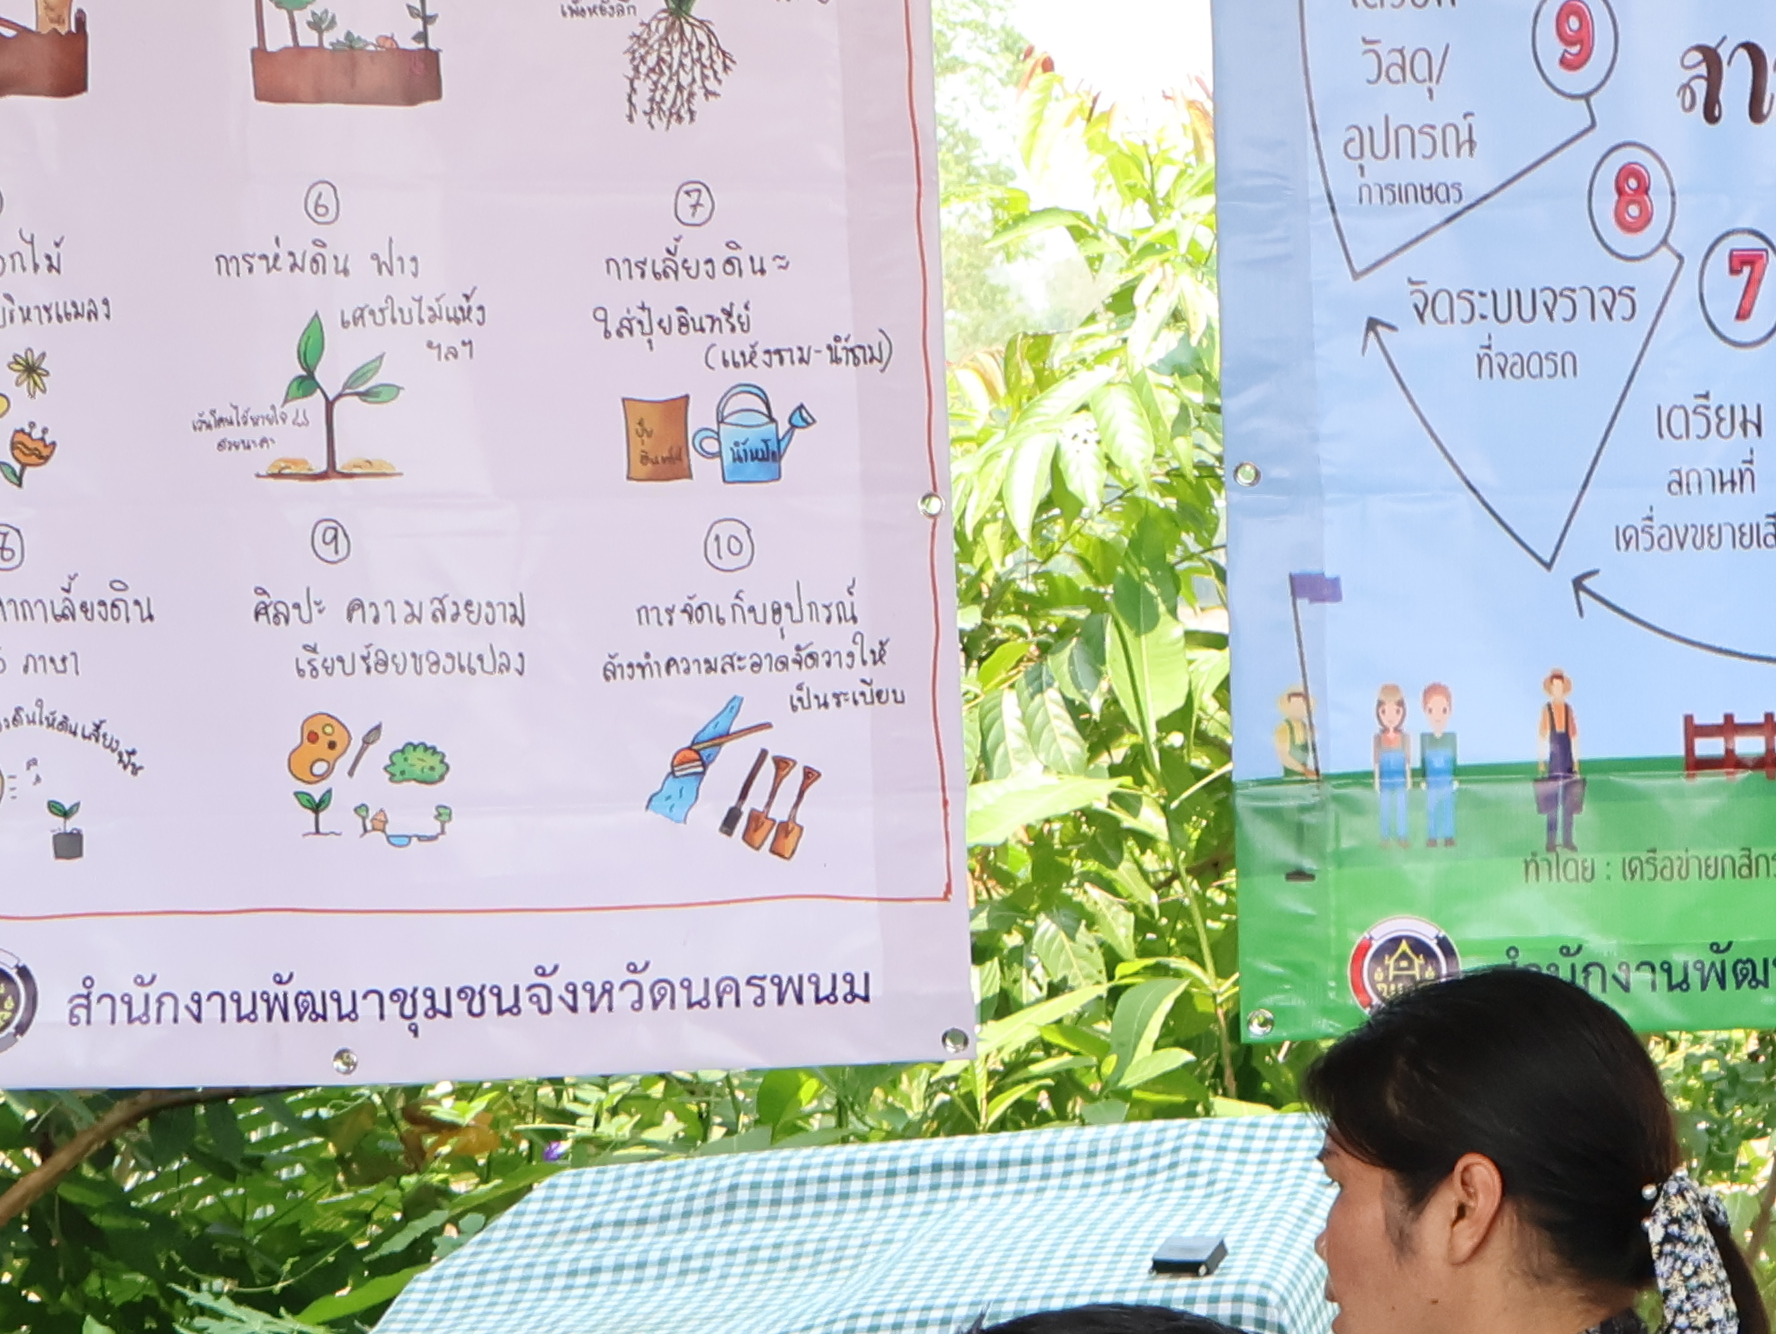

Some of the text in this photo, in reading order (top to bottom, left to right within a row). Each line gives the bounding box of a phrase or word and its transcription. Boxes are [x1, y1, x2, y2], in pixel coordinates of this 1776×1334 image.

[1361, 36, 1451, 101] วัสดุ/
[1343, 112, 1478, 179] อุปกรณ์
[1357, 180, 1464, 207] การเกษตร
[1612, 161, 1655, 236] 8
[215, 236, 421, 278] การห่มดิน ฟาง
[605, 235, 767, 281] การเลี้ยงดิน
[340, 286, 486, 330] เศษใบไม้แห้ง
[1408, 277, 1638, 327] จัดระบบจราจร
[1728, 247, 1769, 323] 7
[593, 301, 752, 350] ใส่ปุ๋ยอินทรีย์
[1476, 333, 1579, 381] ที่จอดรถ
[1656, 391, 1763, 441] เตรียม
[1666, 448, 1757, 497] สถานที่
[253, 587, 525, 627] ศิลปะ ความสวยงาม
[636, 577, 858, 640] การจัดเก็บอุปกรณ์
[22, 651, 79, 676] ภาษา
[602, 631, 889, 682] ล้างทำความสะอาดจัดวางให้
[789, 682, 905, 713] เป็นระเบียบ
[67, 961, 872, 1038] สำนักงานพัฒนาชุมชนจังหวัดนครพนม
